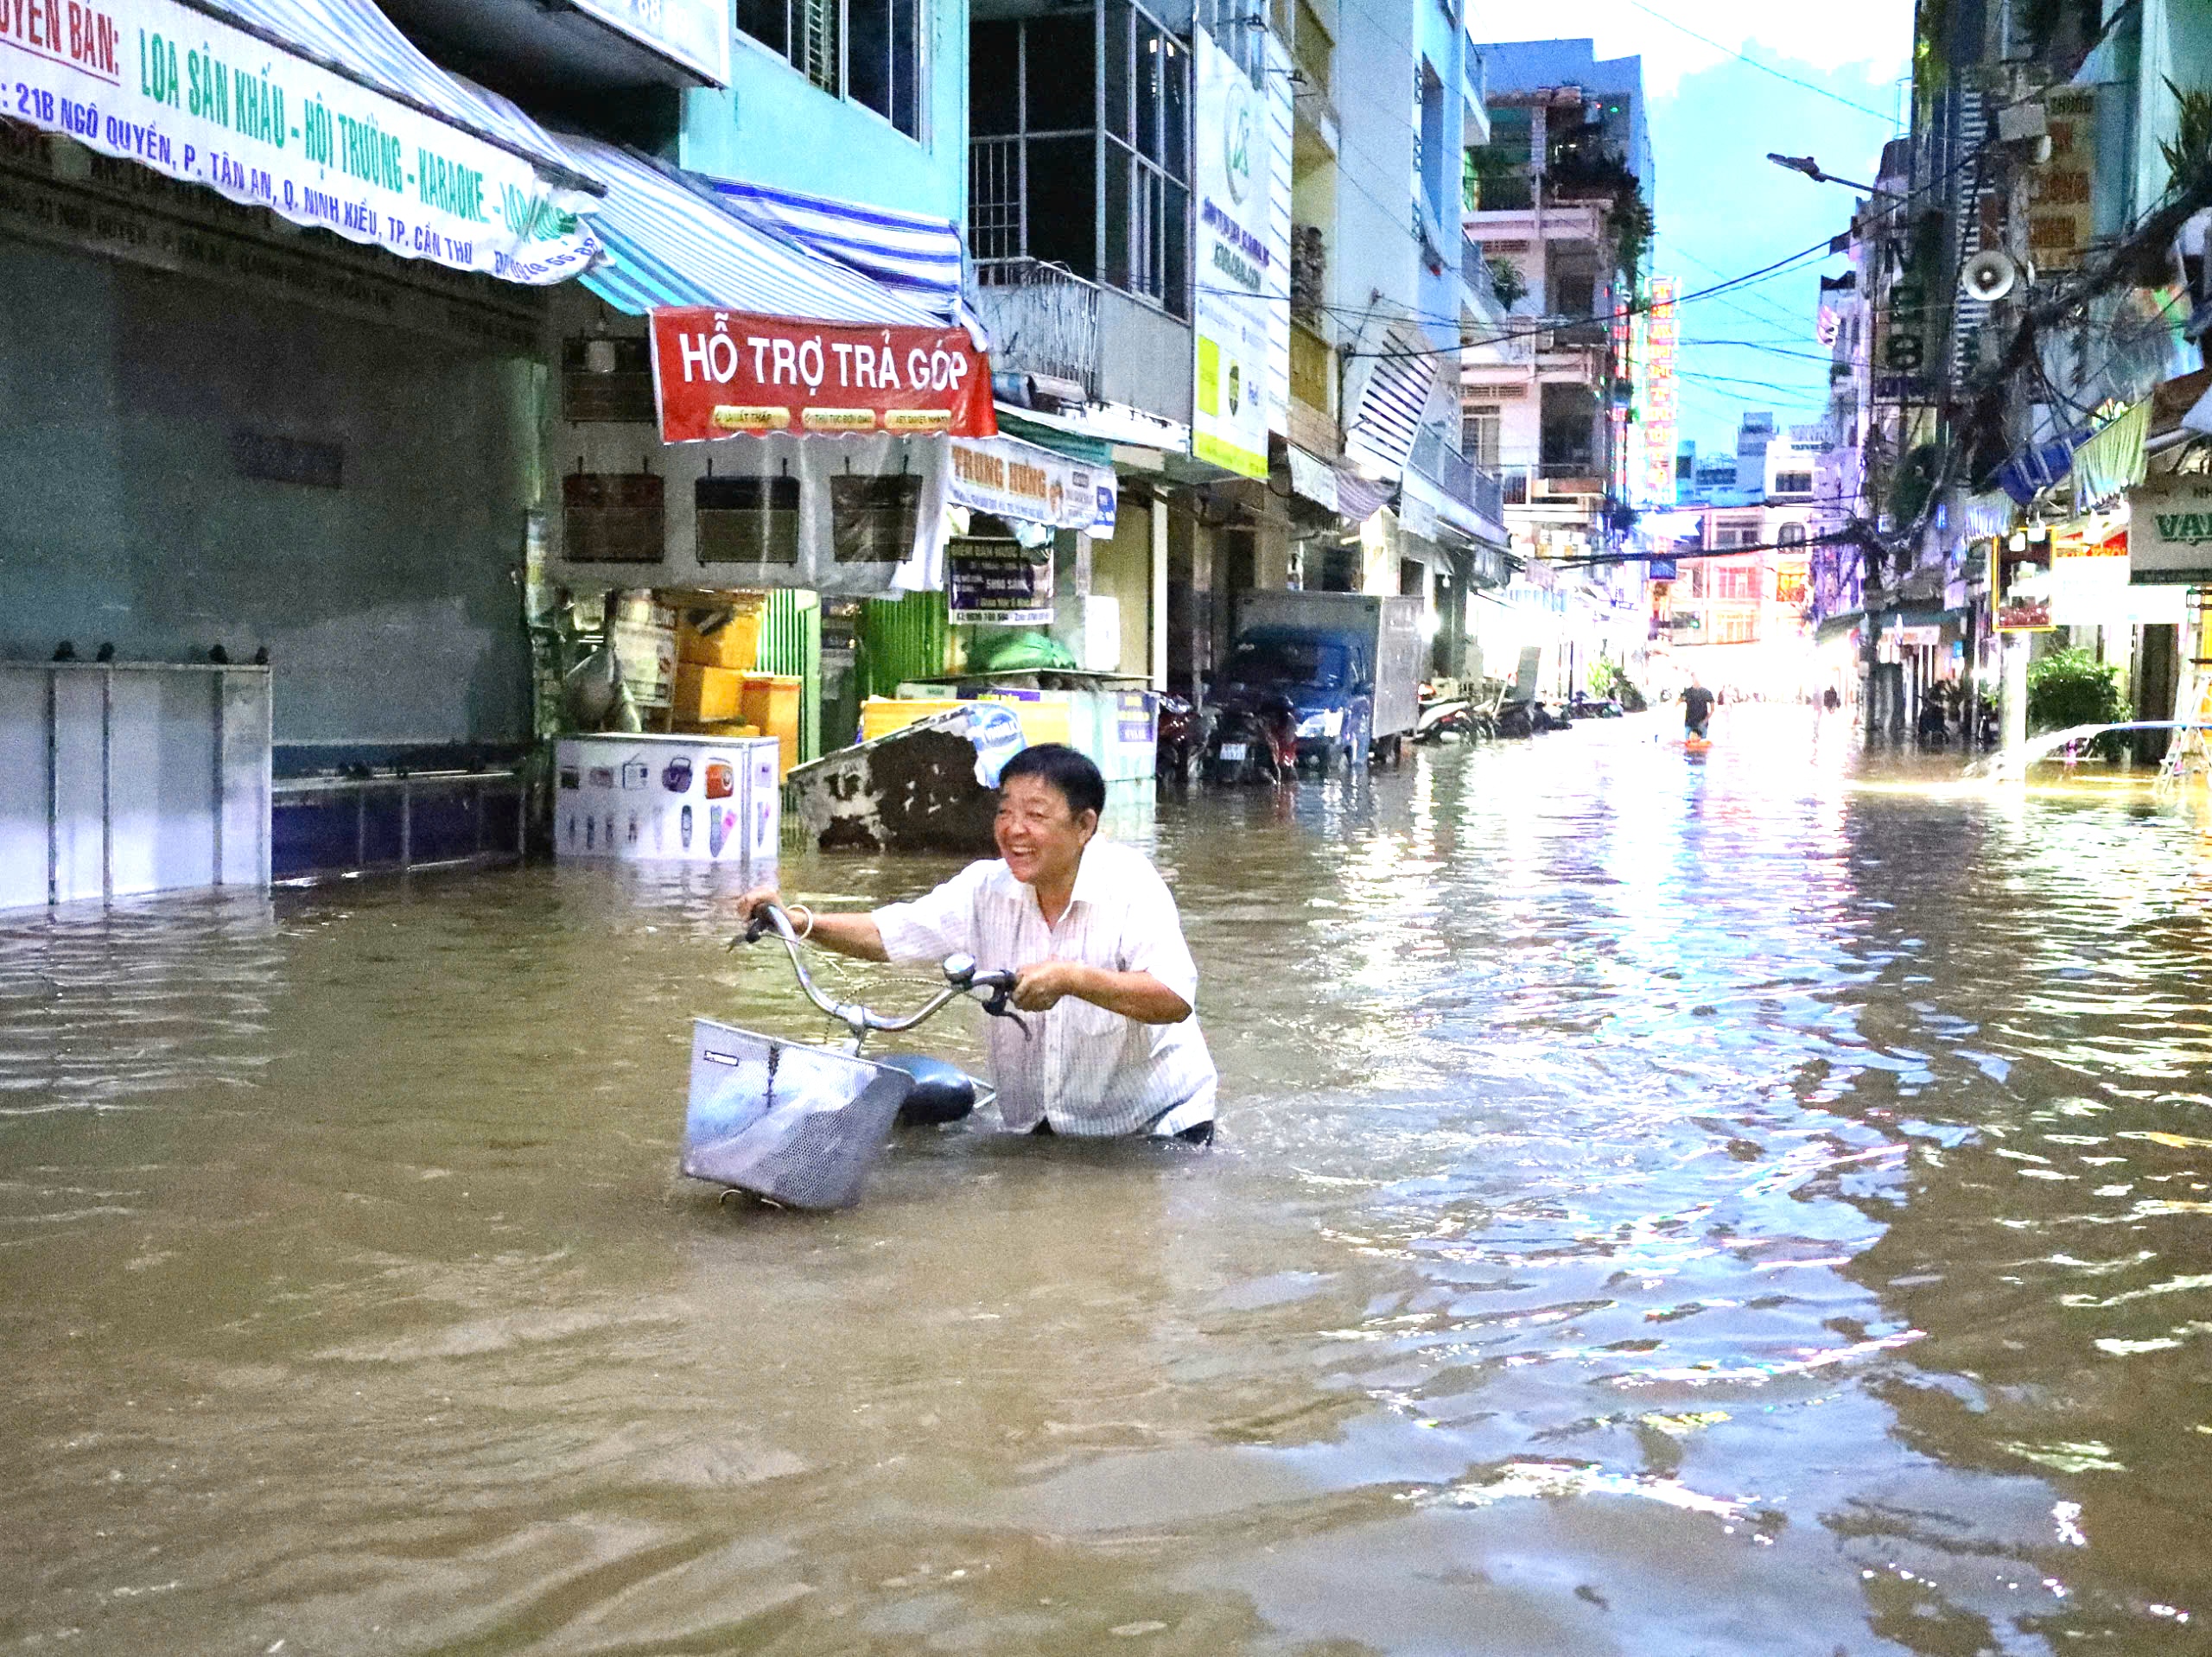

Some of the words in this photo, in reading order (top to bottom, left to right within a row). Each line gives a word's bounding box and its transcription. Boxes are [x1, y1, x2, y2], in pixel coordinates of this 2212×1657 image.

[16, 82, 54, 123] 21B
[61, 101, 99, 139] NGÔ
[210, 151, 245, 190] TÂN
[304, 186, 340, 223] NINH
[388, 216, 410, 247] TP.
[414, 220, 442, 257] CẦN
[444, 236, 474, 265] THƠ
[140, 28, 180, 110] LOA
[188, 41, 229, 128] SÂN
[234, 61, 285, 149] KHẤU
[304, 91, 334, 181] HỘI
[338, 112, 403, 194] TRƯỜNG
[418, 147, 491, 225] KARAOKE
[679, 312, 739, 383] HỖ
[747, 334, 824, 396] TRỢ
[831, 328, 900, 390] TRẢ
[907, 339, 969, 390] GÓP
